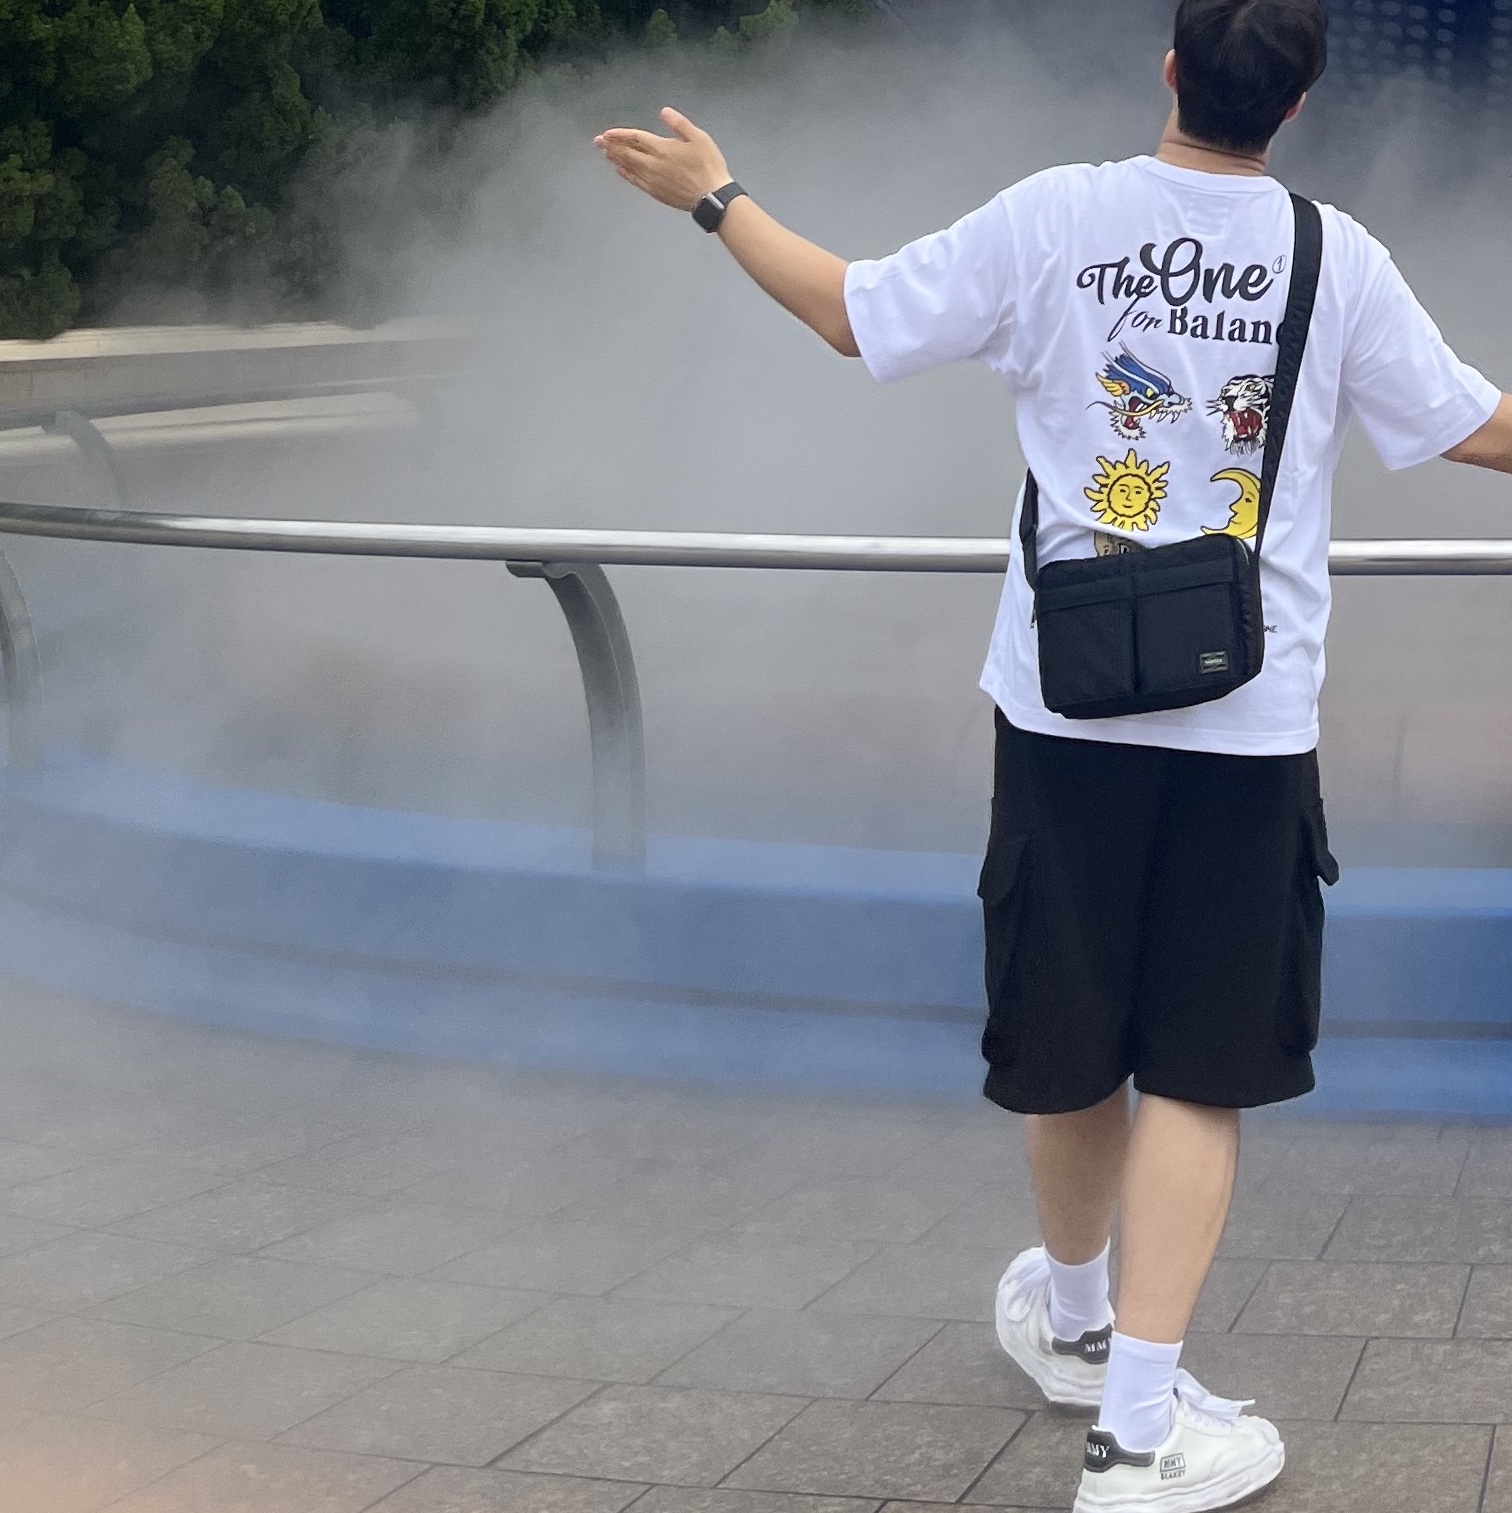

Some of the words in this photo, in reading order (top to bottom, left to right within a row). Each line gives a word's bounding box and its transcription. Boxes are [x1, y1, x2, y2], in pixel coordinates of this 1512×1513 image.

[1076, 256, 1158, 305] The
[1139, 237, 1275, 307] One
[1107, 296, 1163, 343] for
